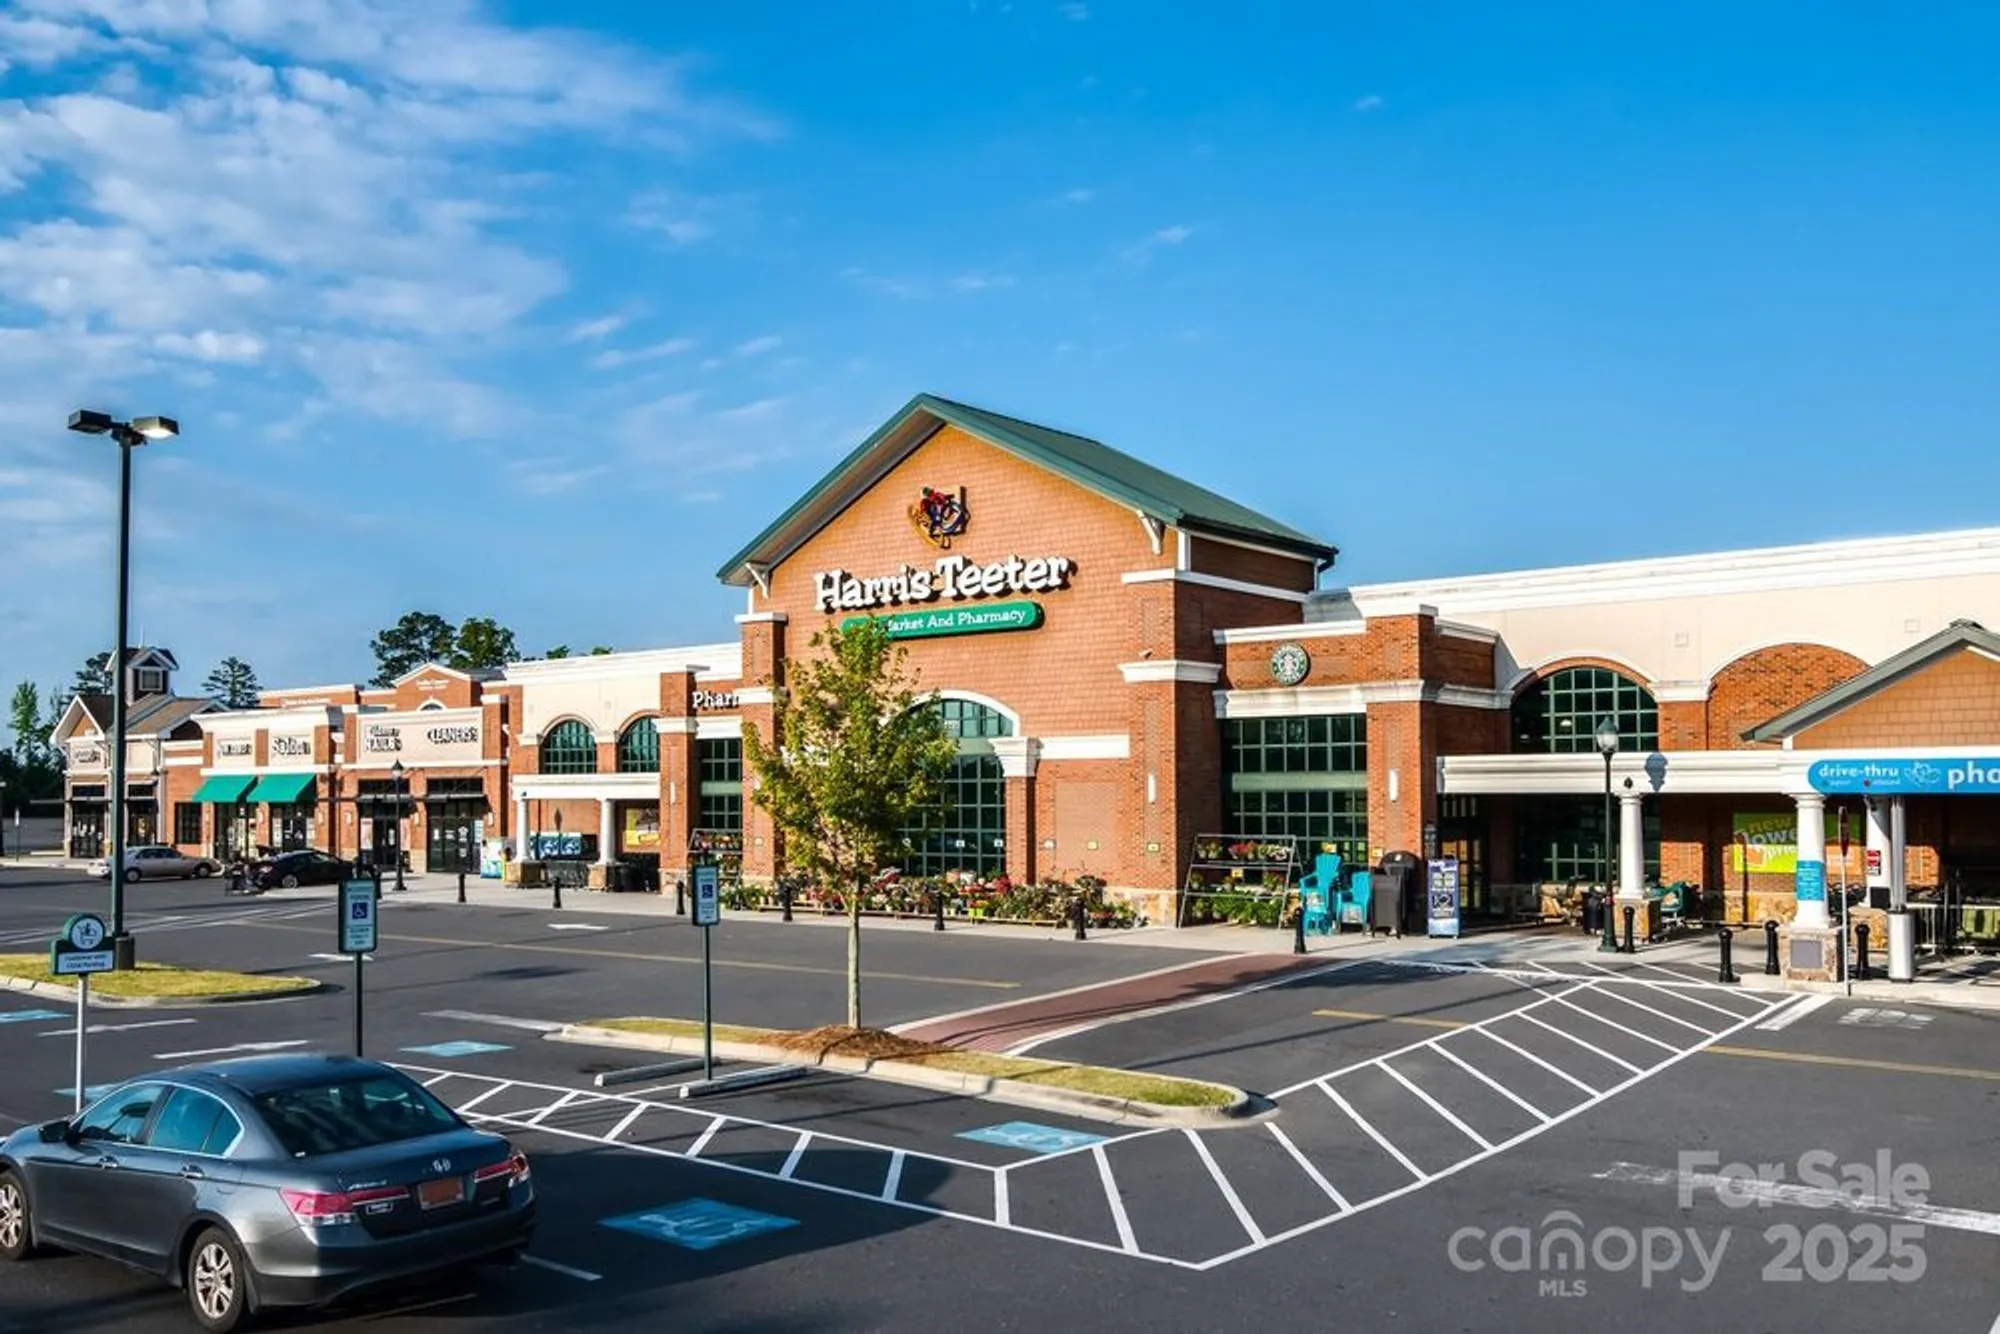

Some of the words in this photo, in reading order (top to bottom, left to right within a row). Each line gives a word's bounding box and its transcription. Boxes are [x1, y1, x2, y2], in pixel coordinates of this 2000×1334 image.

[813, 564, 933, 611] Harris
[935, 553, 1070, 599] Teeter
[927, 612, 954, 628] And
[957, 607, 1026, 626] Pharmacy
[1818, 763, 1900, 779] drive-thru
[1748, 816, 1793, 834] new
